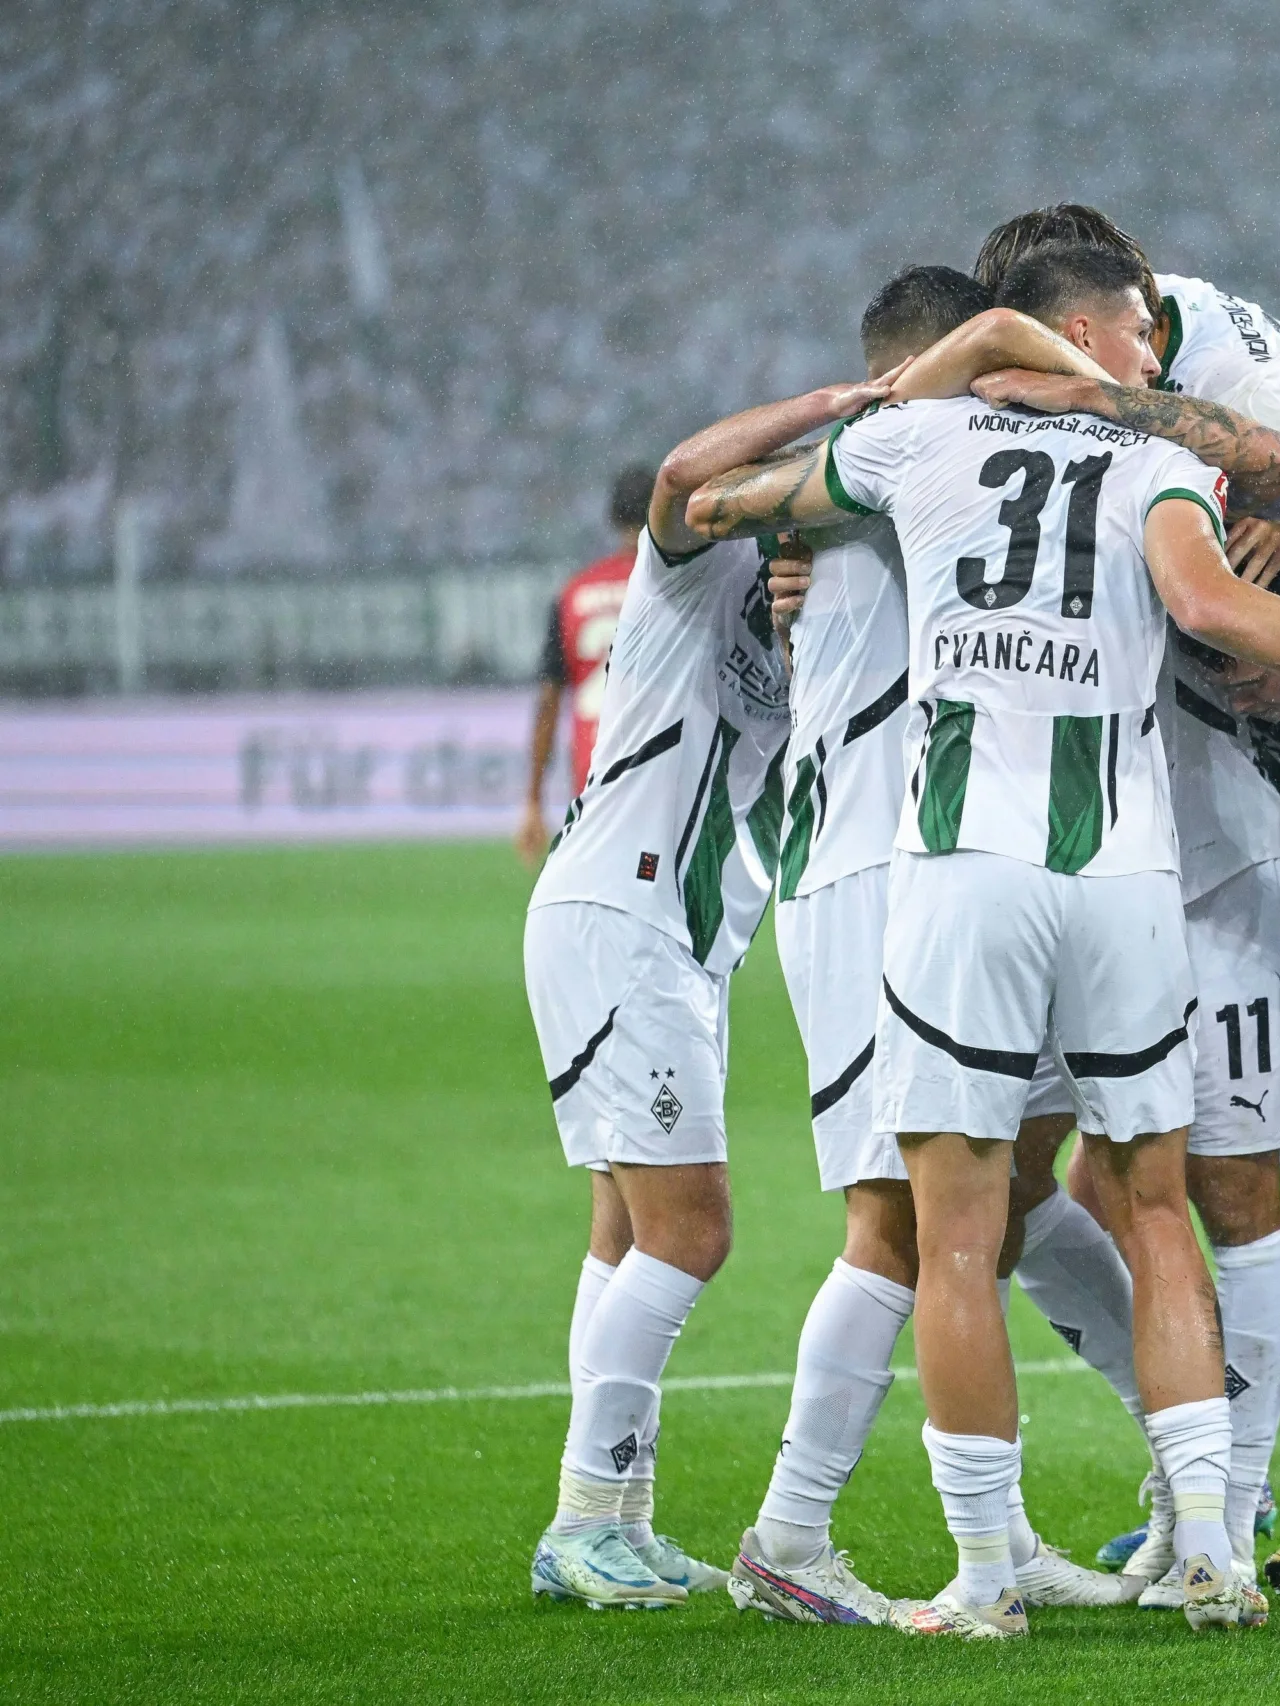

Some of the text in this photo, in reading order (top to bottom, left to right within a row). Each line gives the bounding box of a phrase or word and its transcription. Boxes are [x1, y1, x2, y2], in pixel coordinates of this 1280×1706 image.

[968, 412, 1151, 447] MÖNCENGLADBCH
[956, 448, 1113, 619] 31
[934, 629, 1100, 688] ČVANČARA
[1215, 997, 1272, 1080] 11
